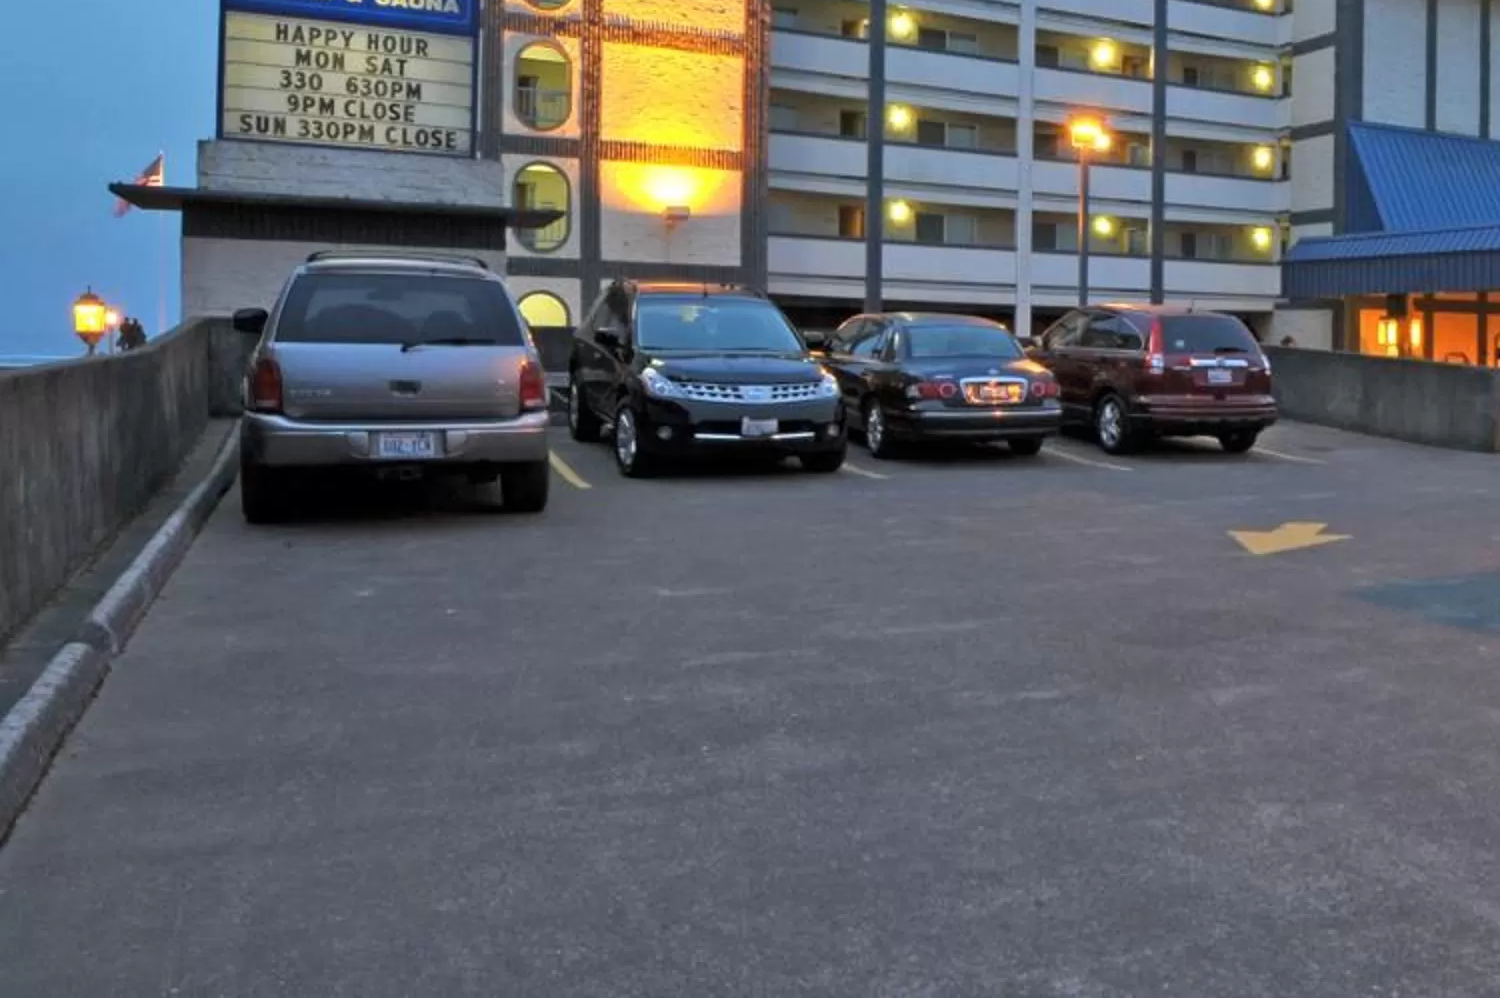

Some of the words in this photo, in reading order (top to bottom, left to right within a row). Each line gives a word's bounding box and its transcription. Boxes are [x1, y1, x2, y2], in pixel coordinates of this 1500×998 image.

[275, 23, 354, 48] HAPPY
[367, 34, 429, 56] HOUR
[295, 49, 346, 71] MON
[366, 56, 408, 77] SAT
[280, 69, 323, 91] 330
[345, 77, 422, 101] 630PM
[287, 94, 335, 116] 9PM
[344, 100, 416, 123] CLOSE
[239, 114, 286, 135] SUN
[299, 119, 374, 143] 330PM
[385, 126, 457, 149] CLOSE
